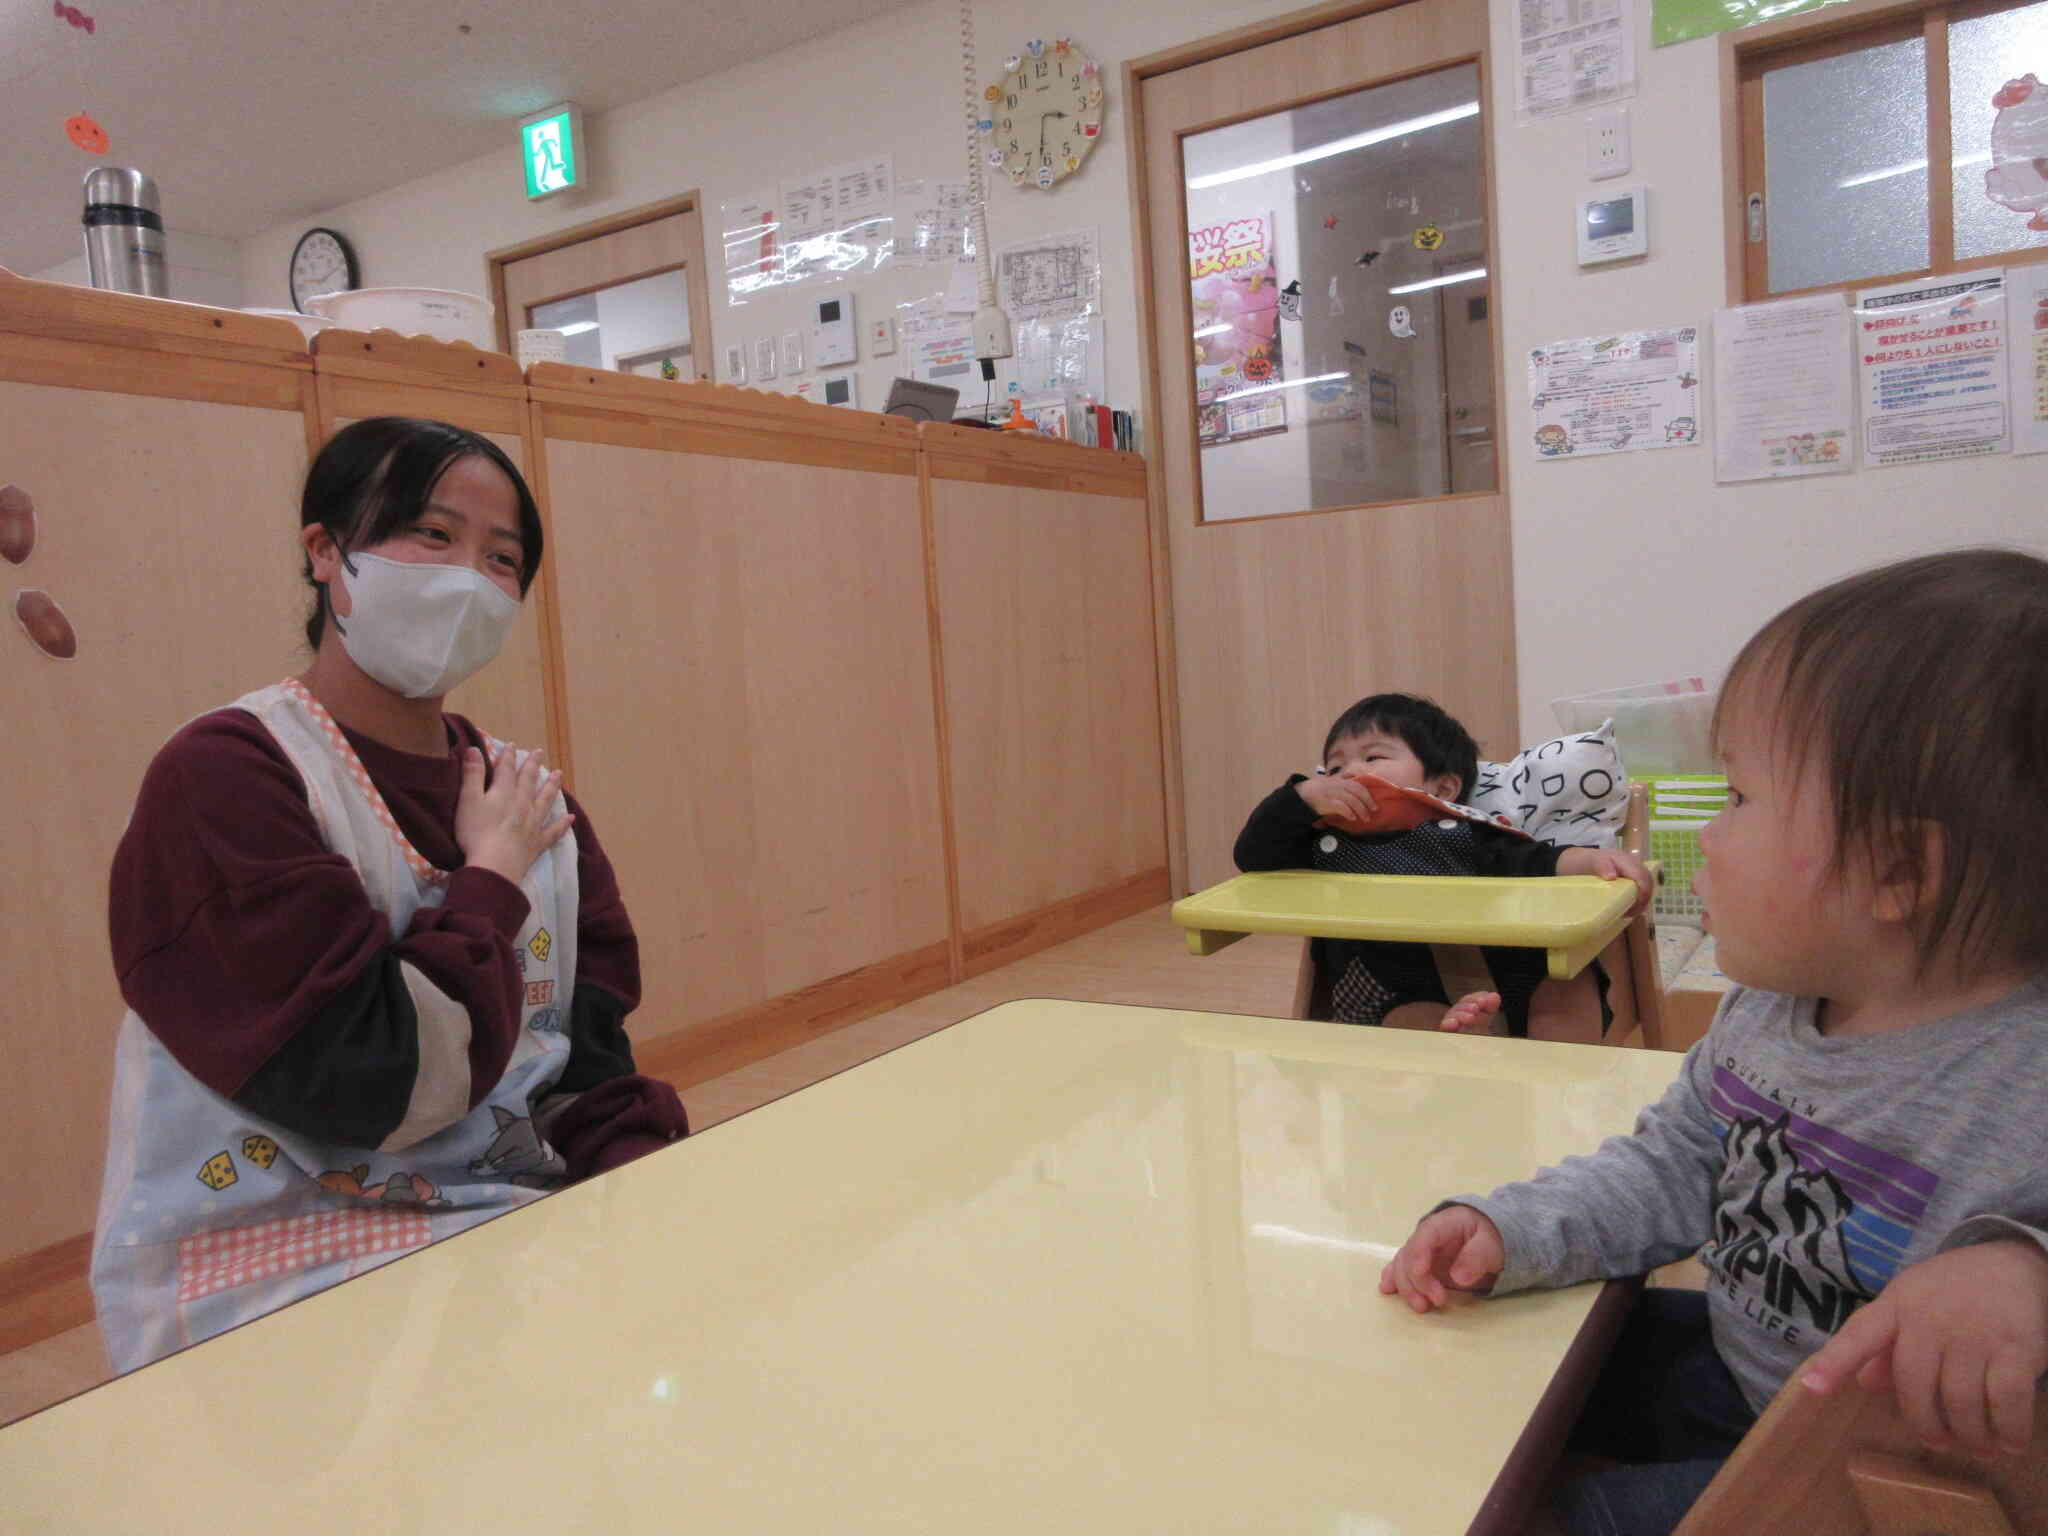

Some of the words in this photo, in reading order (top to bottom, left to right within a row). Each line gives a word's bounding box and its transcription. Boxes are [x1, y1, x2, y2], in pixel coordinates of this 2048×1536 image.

[1035, 61, 1048, 78] 12
[1057, 62, 1063, 78] 1
[1018, 74, 1028, 89] 11
[1072, 74, 1080, 91] 2
[1006, 94, 1018, 110] 10
[1078, 96, 1087, 112] 3
[1003, 118, 1012, 133] 9
[1073, 121, 1081, 136] 4
[1010, 139, 1018, 153] 8
[1062, 142, 1071, 157] 5
[1024, 152, 1032, 166] 7
[1043, 152, 1052, 166] 6
[1541, 773, 1565, 796] D
[1580, 769, 1613, 799] O
[1743, 1296, 1801, 1345] LIFE
